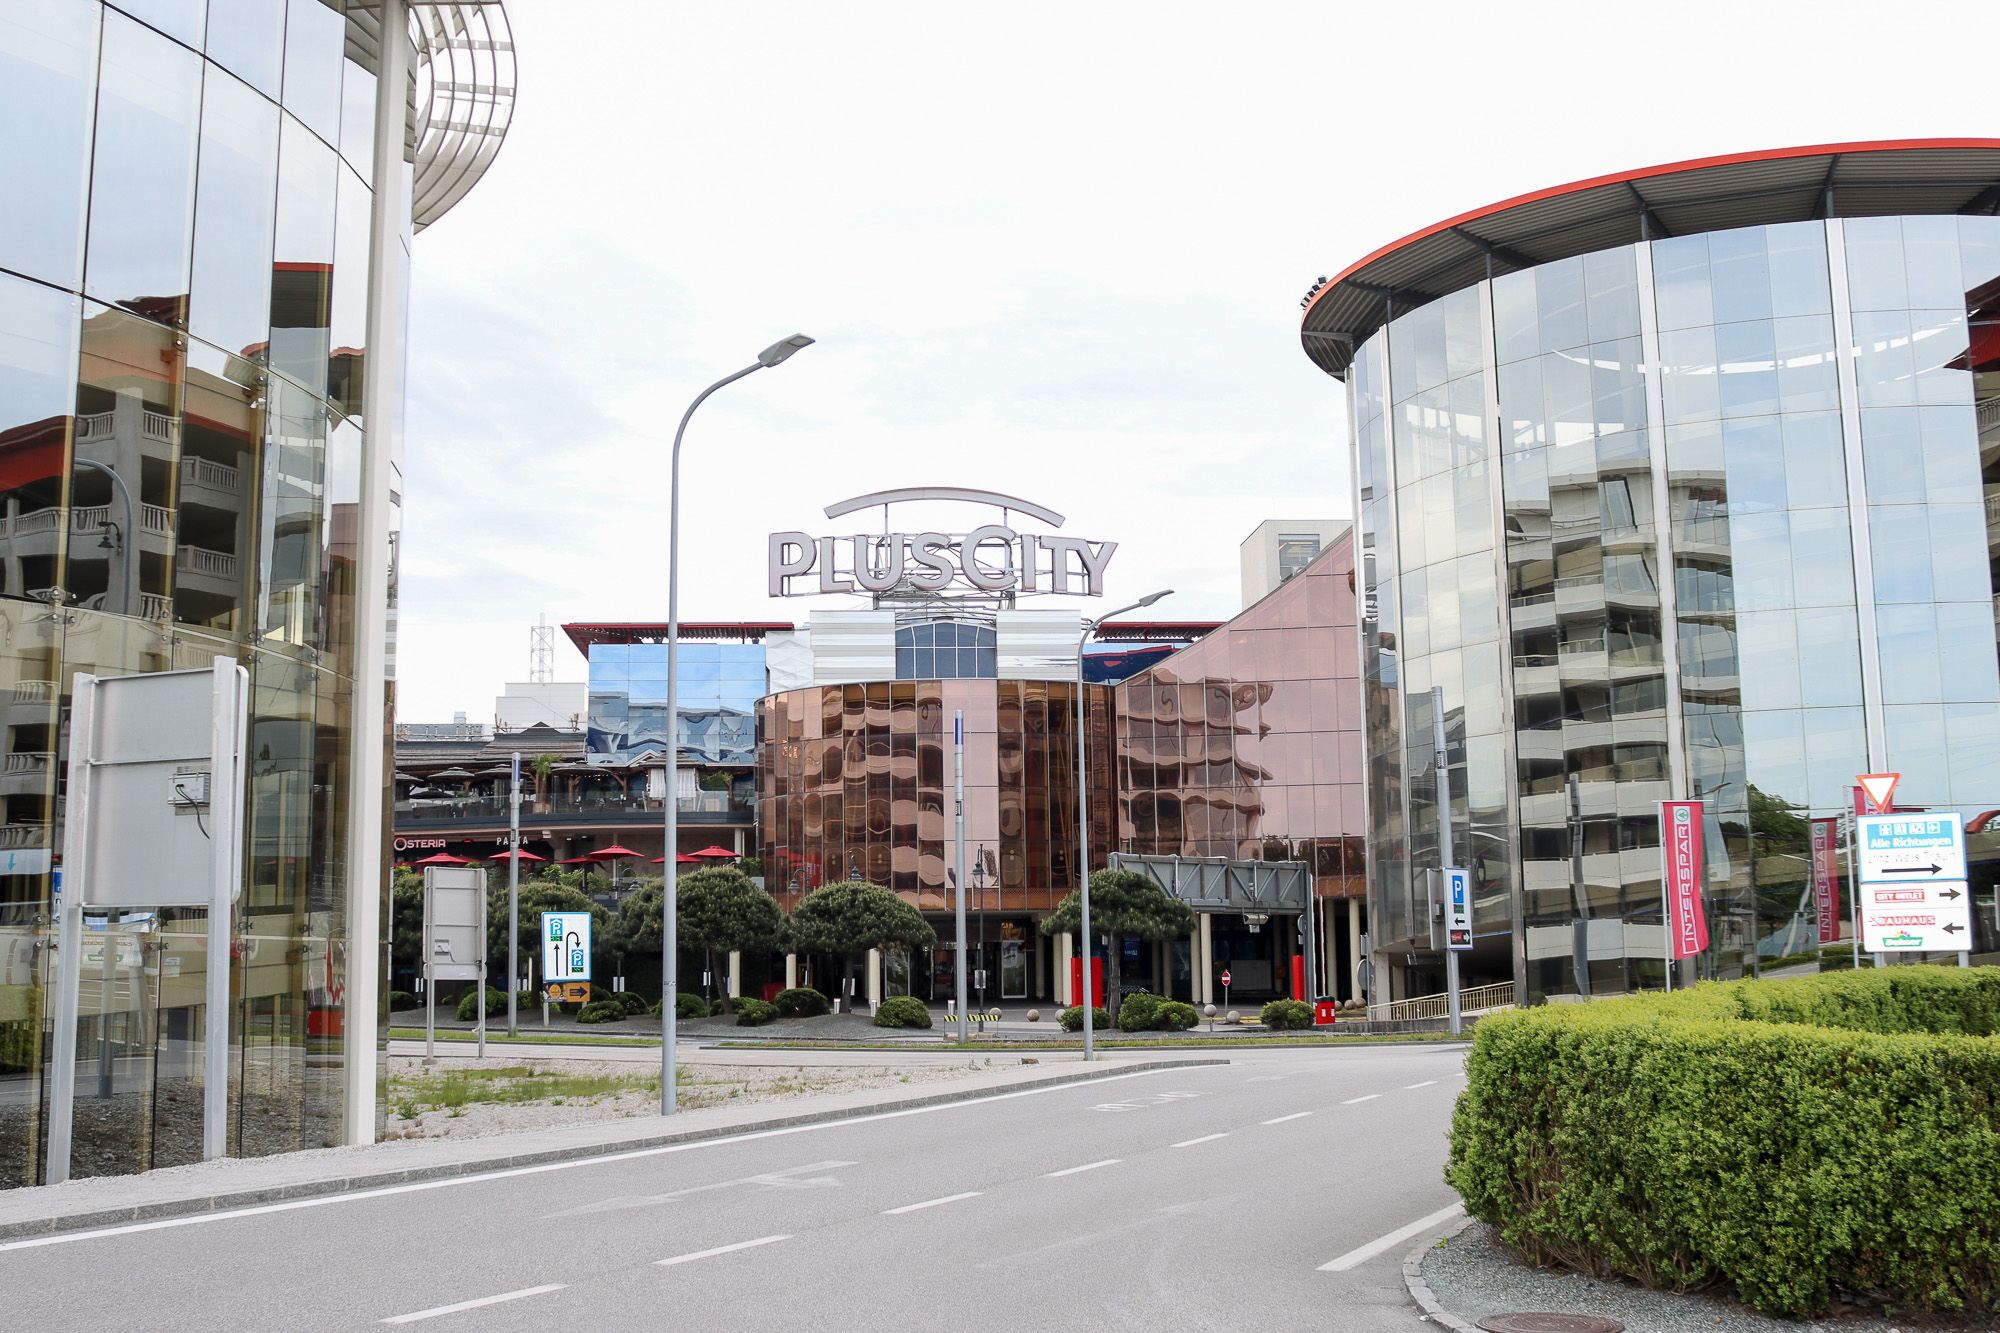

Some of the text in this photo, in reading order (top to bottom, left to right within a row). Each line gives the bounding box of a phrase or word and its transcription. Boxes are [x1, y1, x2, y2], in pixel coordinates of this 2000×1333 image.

[768, 524, 1119, 598] PLUSCITY
[393, 837, 446, 851] OSTERIA
[1871, 836, 1952, 850] Alle Richtungen
[1454, 880, 1462, 899] P
[1678, 826, 1694, 941] INTERSPAR
[1877, 916, 1936, 926] BAUHAUS
